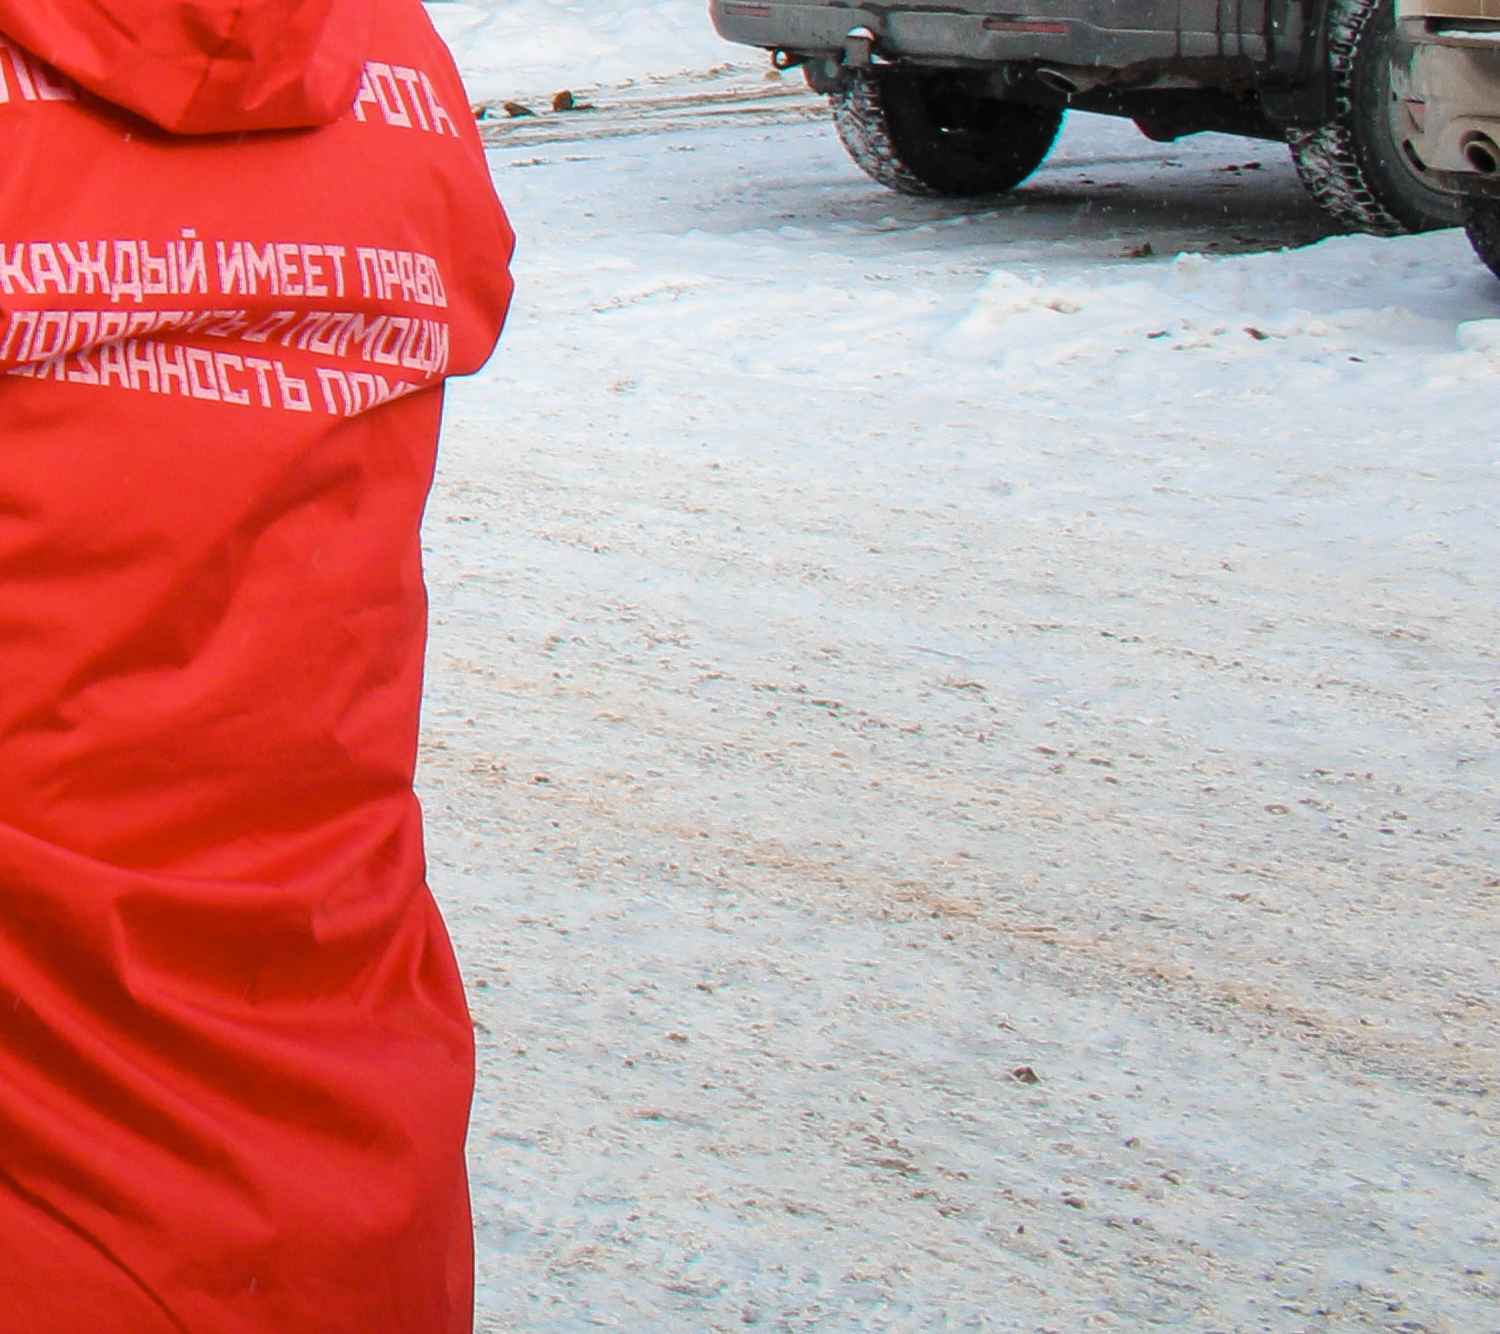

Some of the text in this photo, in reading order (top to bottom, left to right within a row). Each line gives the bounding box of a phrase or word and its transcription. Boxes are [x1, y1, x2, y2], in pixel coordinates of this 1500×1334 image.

[216, 241, 346, 297] ИМЕЕТ
[356, 246, 448, 308] ПРАВО
[281, 310, 449, 378] ПОМОЩИ
